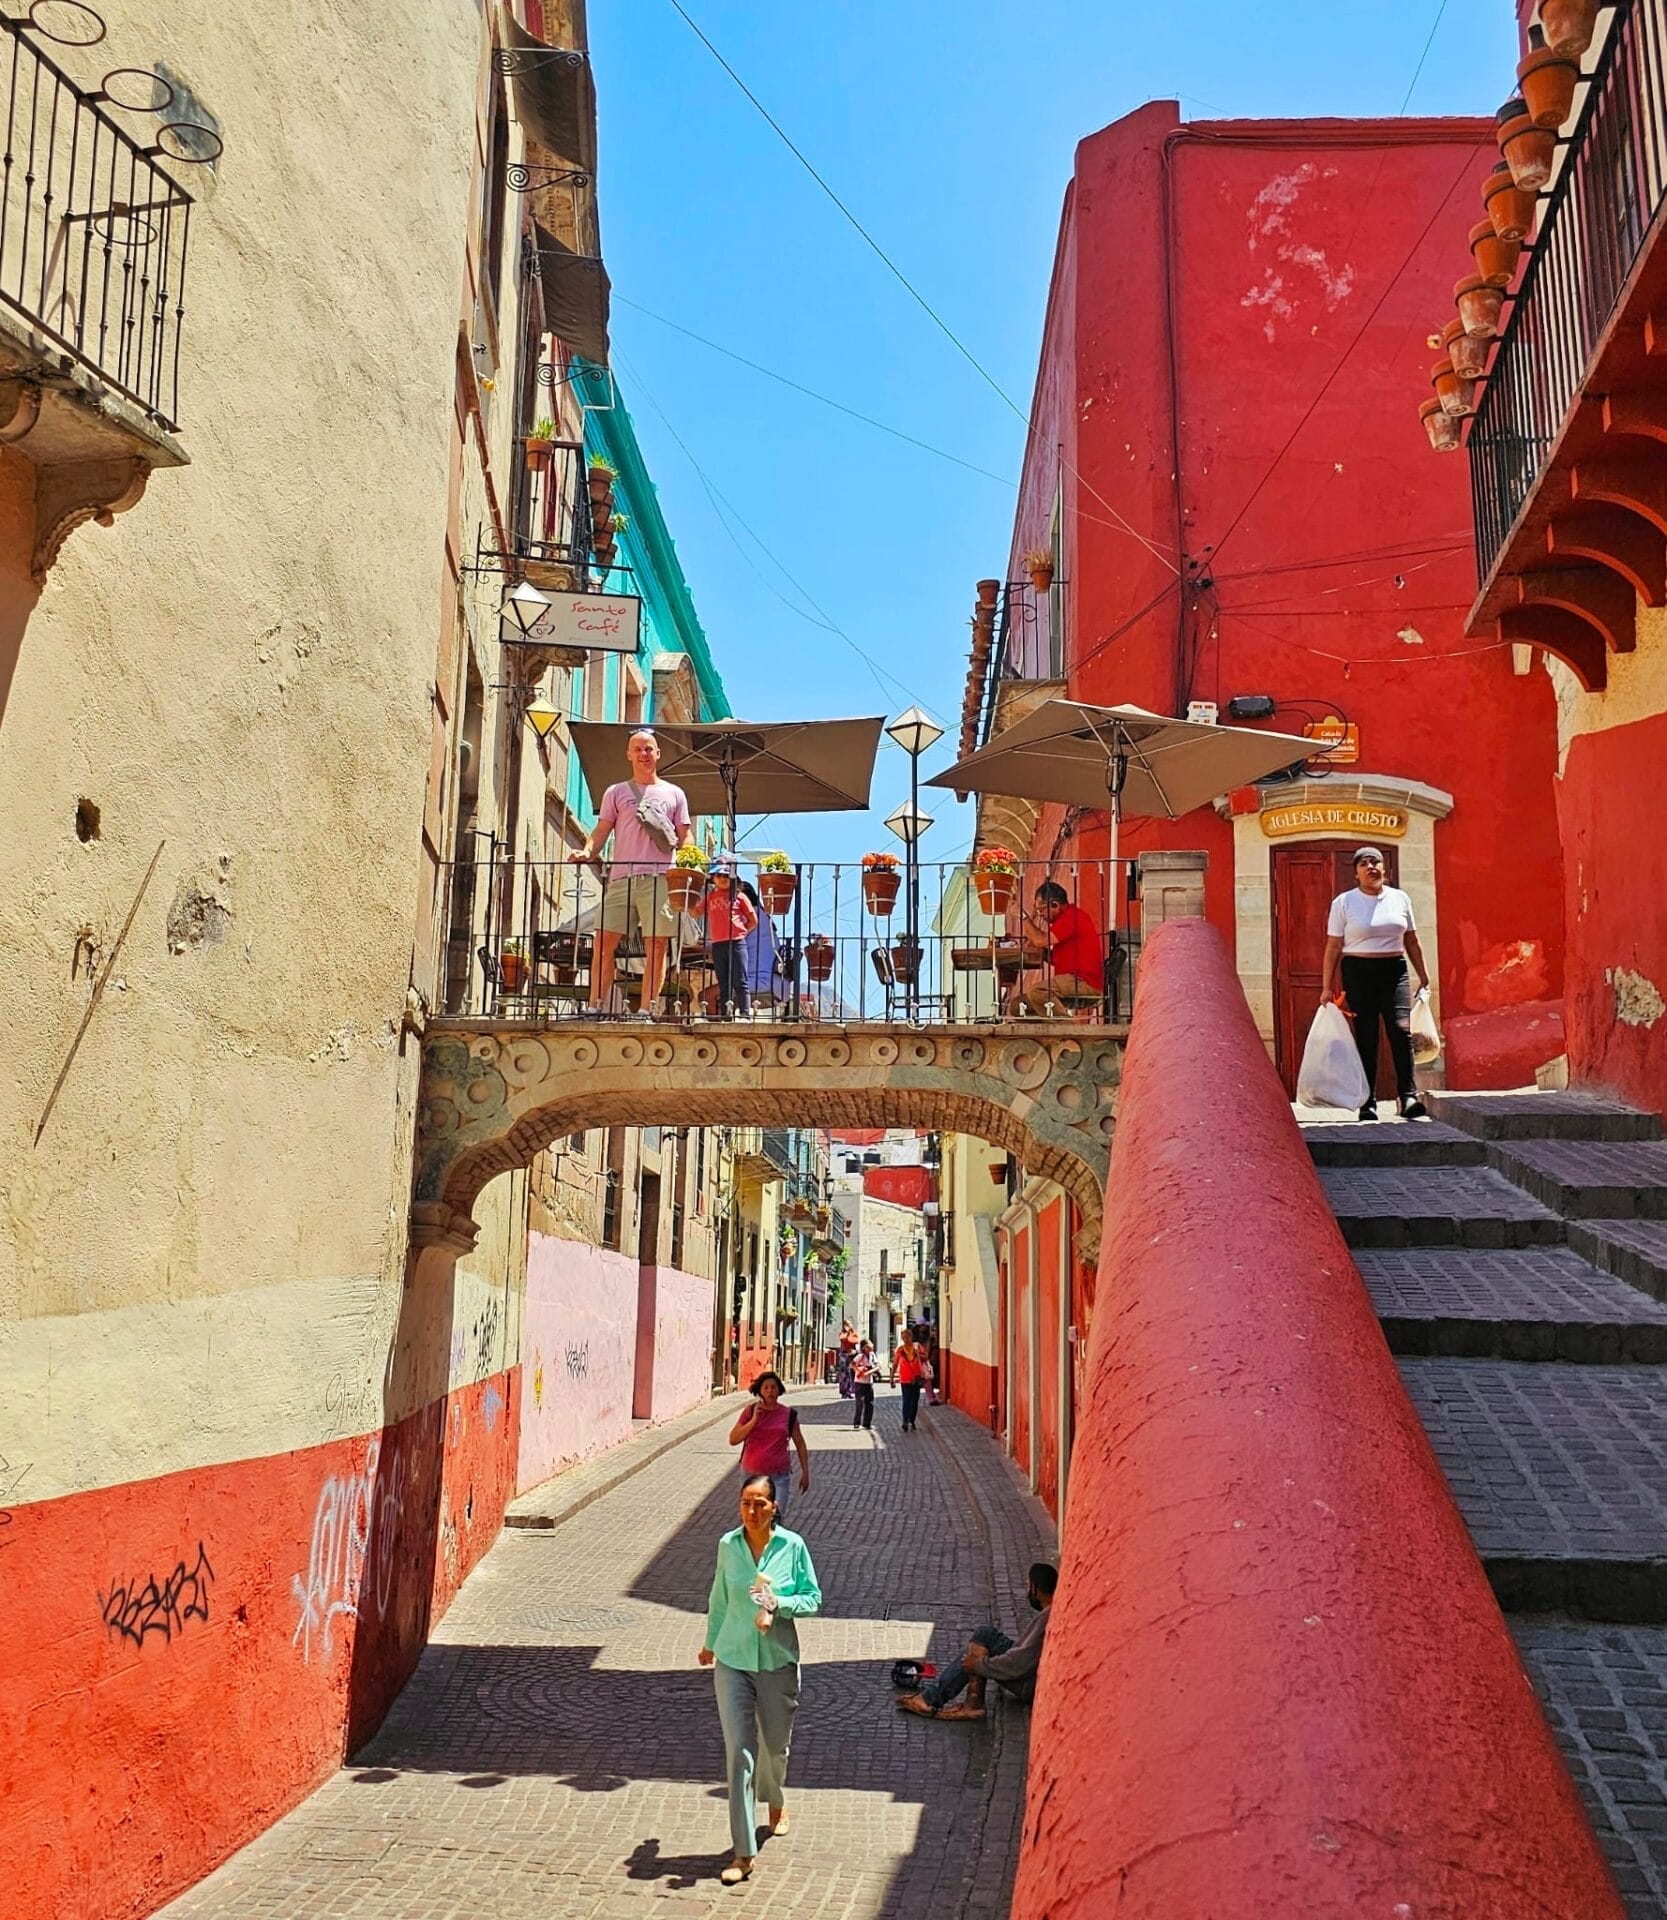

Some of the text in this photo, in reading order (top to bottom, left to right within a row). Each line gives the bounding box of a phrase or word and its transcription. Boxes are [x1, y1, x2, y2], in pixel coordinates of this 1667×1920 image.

[571, 601, 626, 615] Santo
[578, 618, 620, 636] Café
[1271, 810, 1398, 829] IGLESIA DE CRISTO
